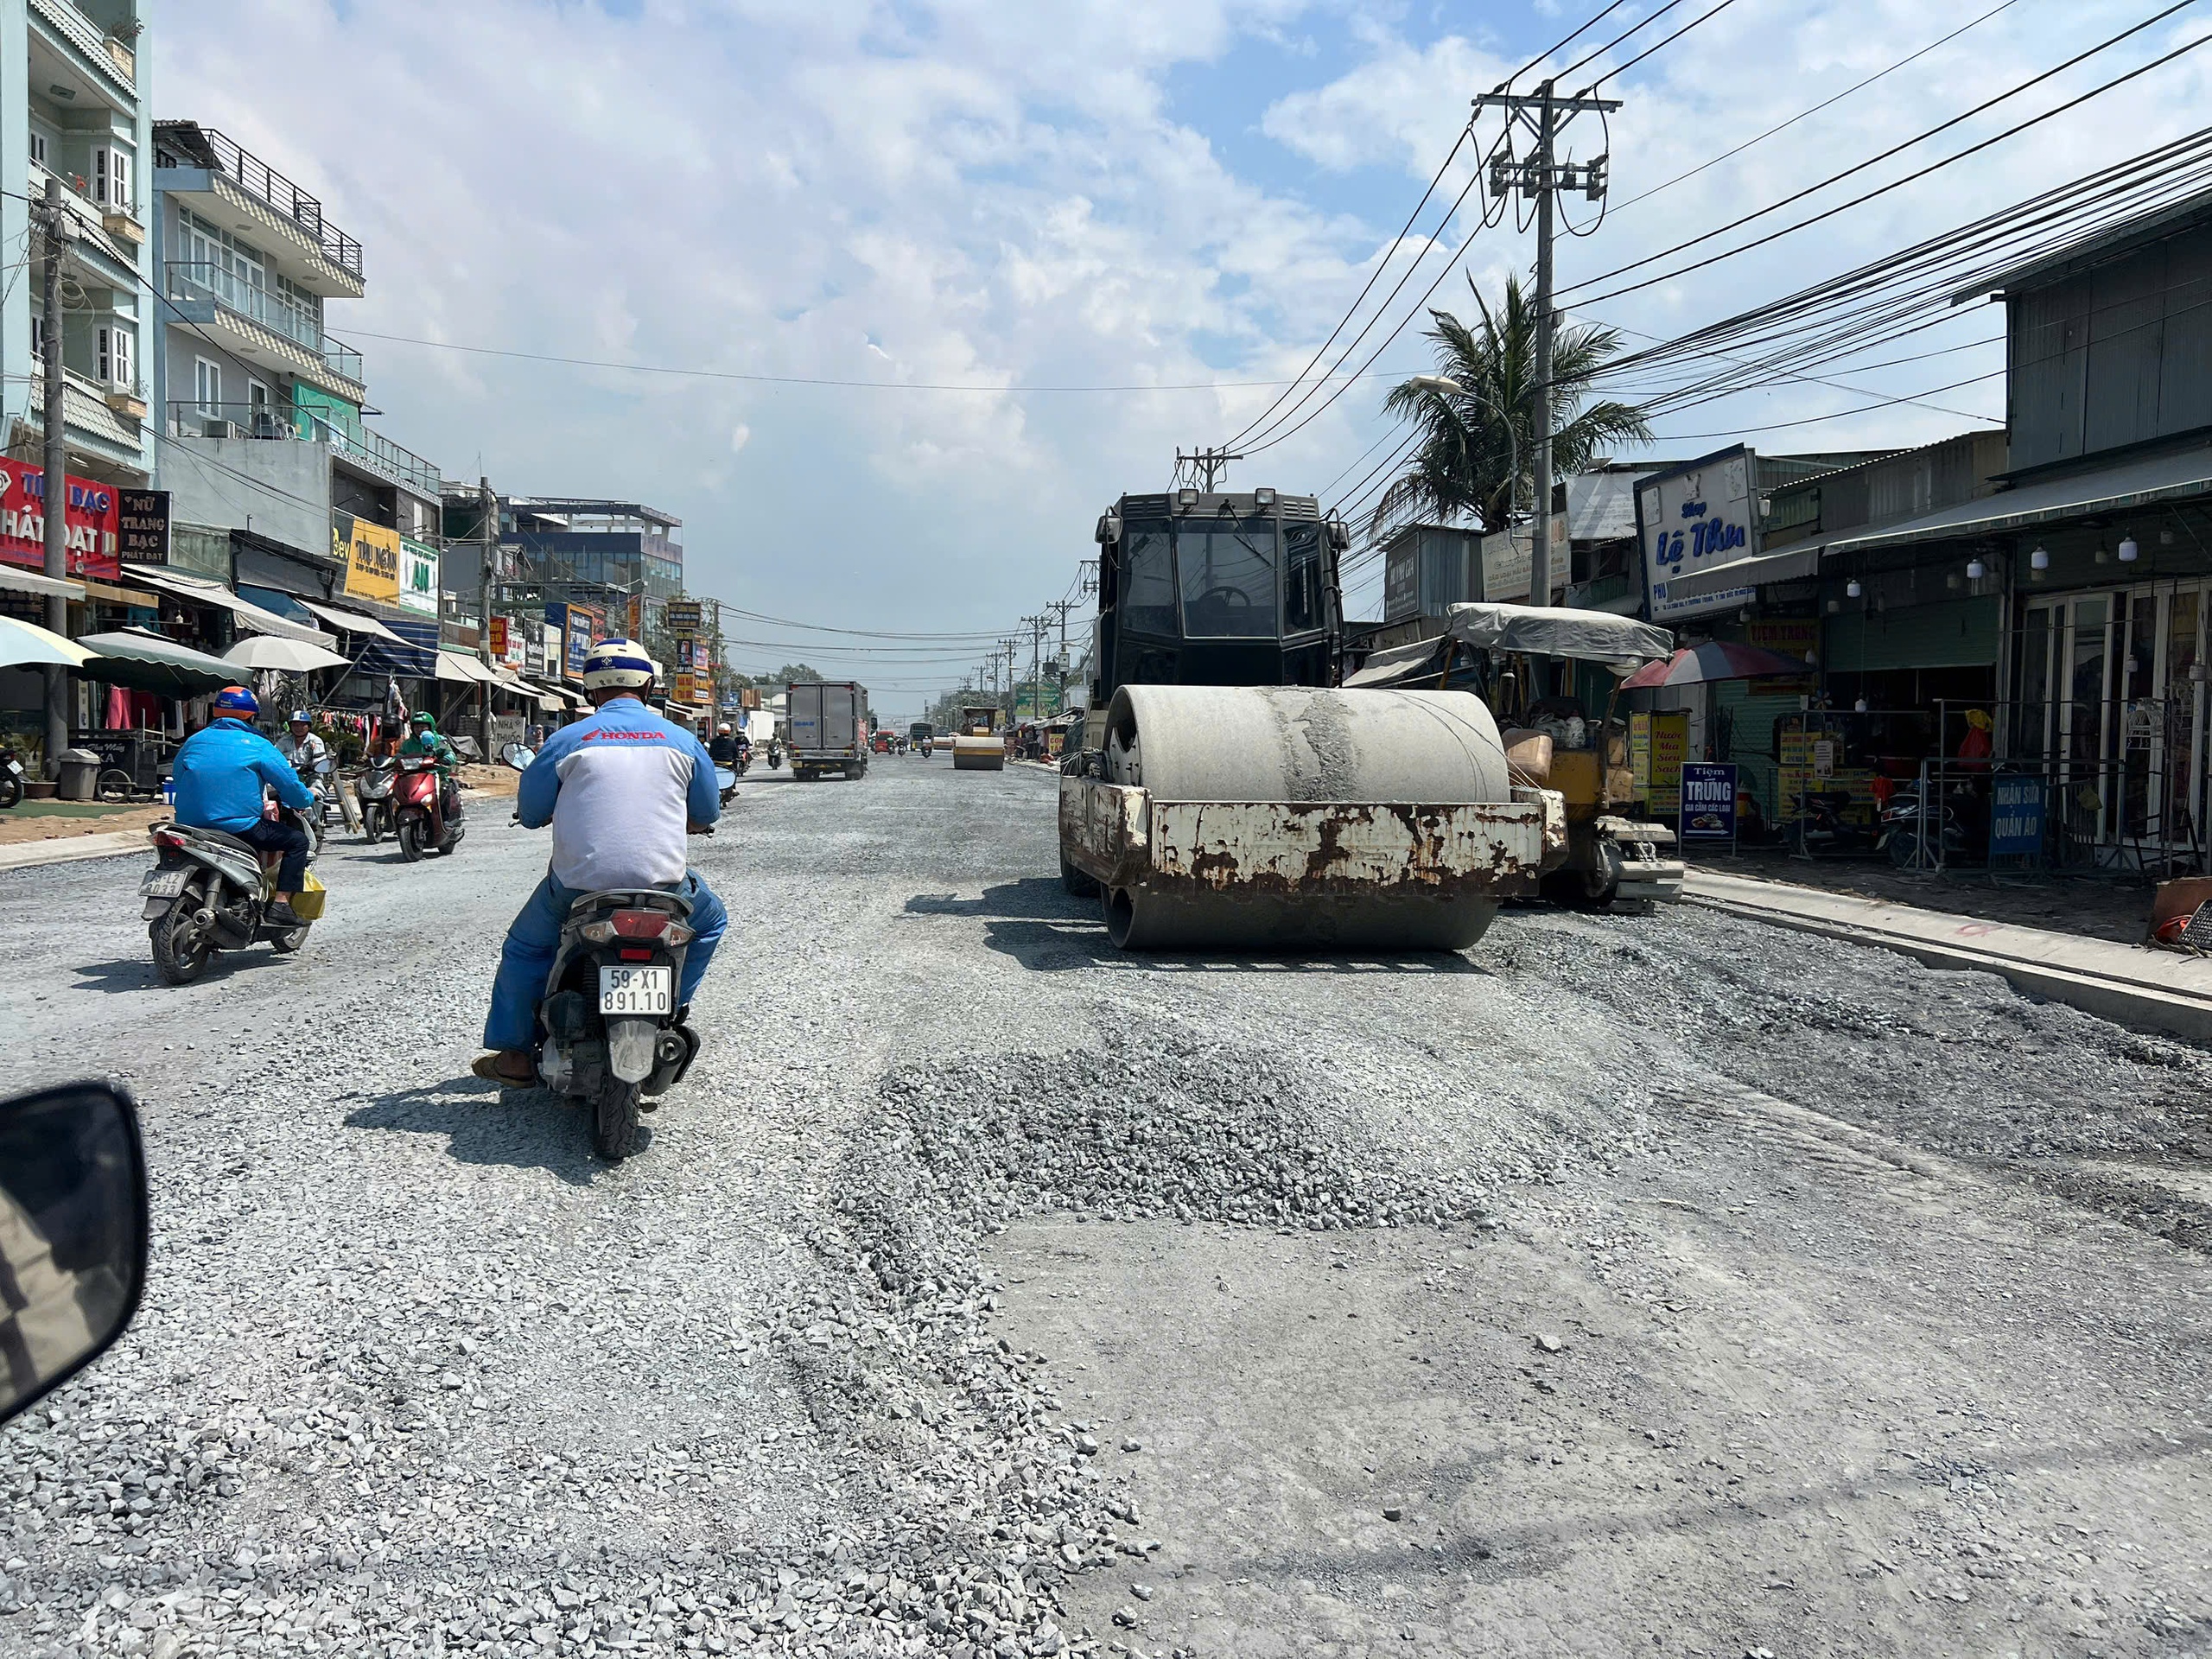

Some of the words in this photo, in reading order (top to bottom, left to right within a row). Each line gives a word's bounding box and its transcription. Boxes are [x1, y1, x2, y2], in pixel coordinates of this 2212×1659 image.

[69, 484, 111, 514] BẠC
[133, 496, 156, 512] NỮ
[120, 516, 165, 531] TRANG
[128, 533, 159, 550] BẠC
[1656, 530, 1684, 574] Lệ
[499, 719, 513, 729] NHÀ
[497, 731, 521, 742] THUỐC
[601, 731, 667, 740] HONDA
[1694, 767, 1725, 777] Tiệm
[1687, 778, 1732, 801] TRỨNG
[1996, 782, 2022, 809] NHẬN
[1994, 810, 2023, 840] QUẦN
[2024, 812, 2037, 836] ÁO
[611, 969, 658, 989] 59-X1
[604, 991, 666, 1011] 891.10
